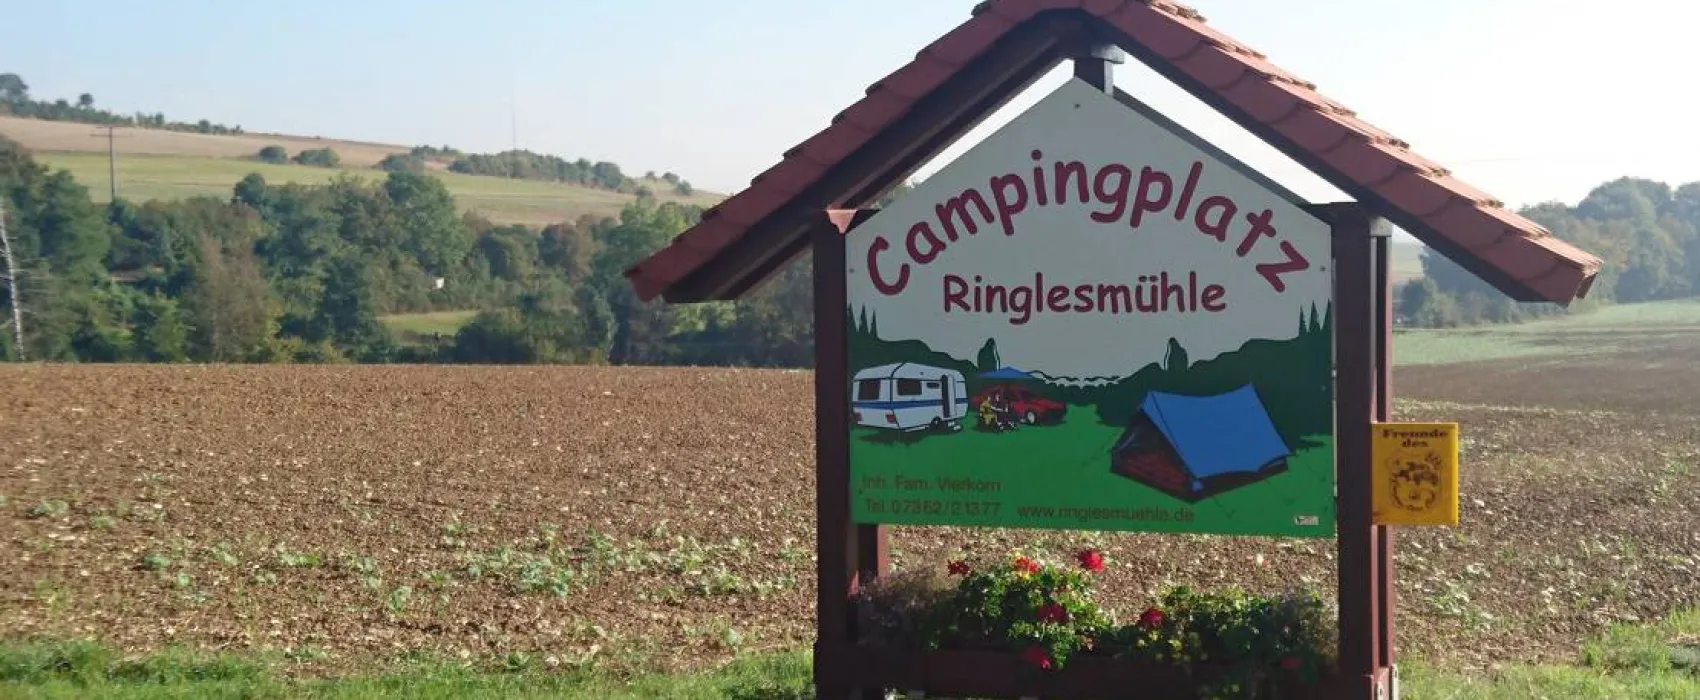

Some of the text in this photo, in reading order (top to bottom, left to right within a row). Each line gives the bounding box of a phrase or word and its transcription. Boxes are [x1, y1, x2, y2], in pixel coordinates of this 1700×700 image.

[866, 149, 1310, 295] Campingplatz
[942, 270, 1227, 325] Ringlesmühle
[1382, 428, 1448, 439] Freunde
[1402, 438, 1428, 448] des
